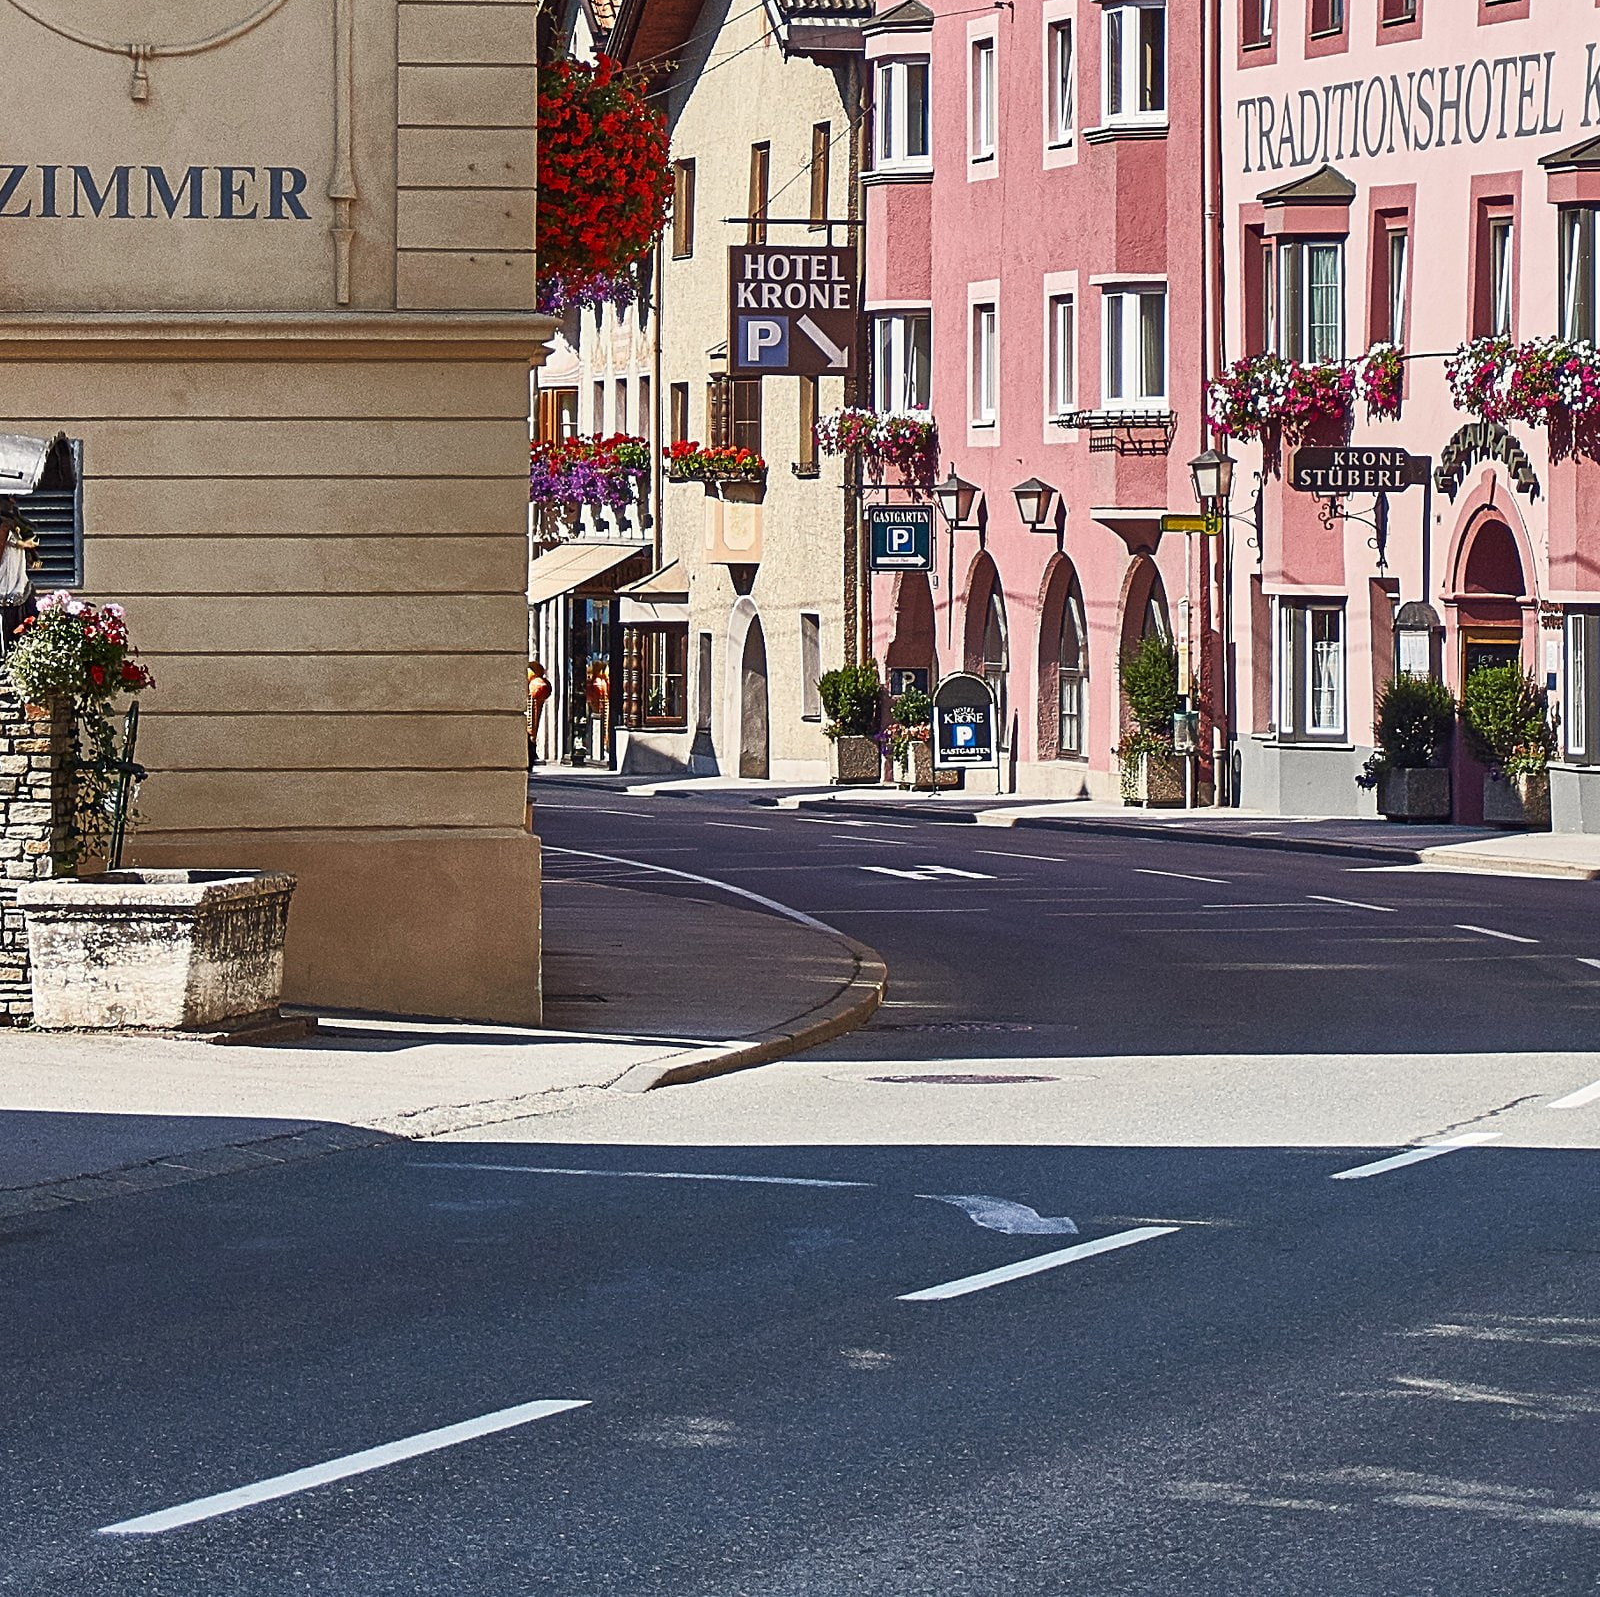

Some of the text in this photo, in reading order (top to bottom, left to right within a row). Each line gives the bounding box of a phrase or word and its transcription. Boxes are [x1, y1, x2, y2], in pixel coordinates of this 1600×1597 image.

[1237, 50, 1563, 174] TRADITIONSHOTEL
[743, 253, 846, 281] HOTEL
[737, 282, 851, 309] KRONE
[747, 320, 782, 362] P
[1334, 451, 1405, 466] KRONE
[1300, 466, 1405, 487] STÜBERL
[872, 510, 929, 523] GASTGARTEN
[892, 529, 909, 551] P
[943, 712, 985, 724] KRONE
[956, 726, 973, 746] P
